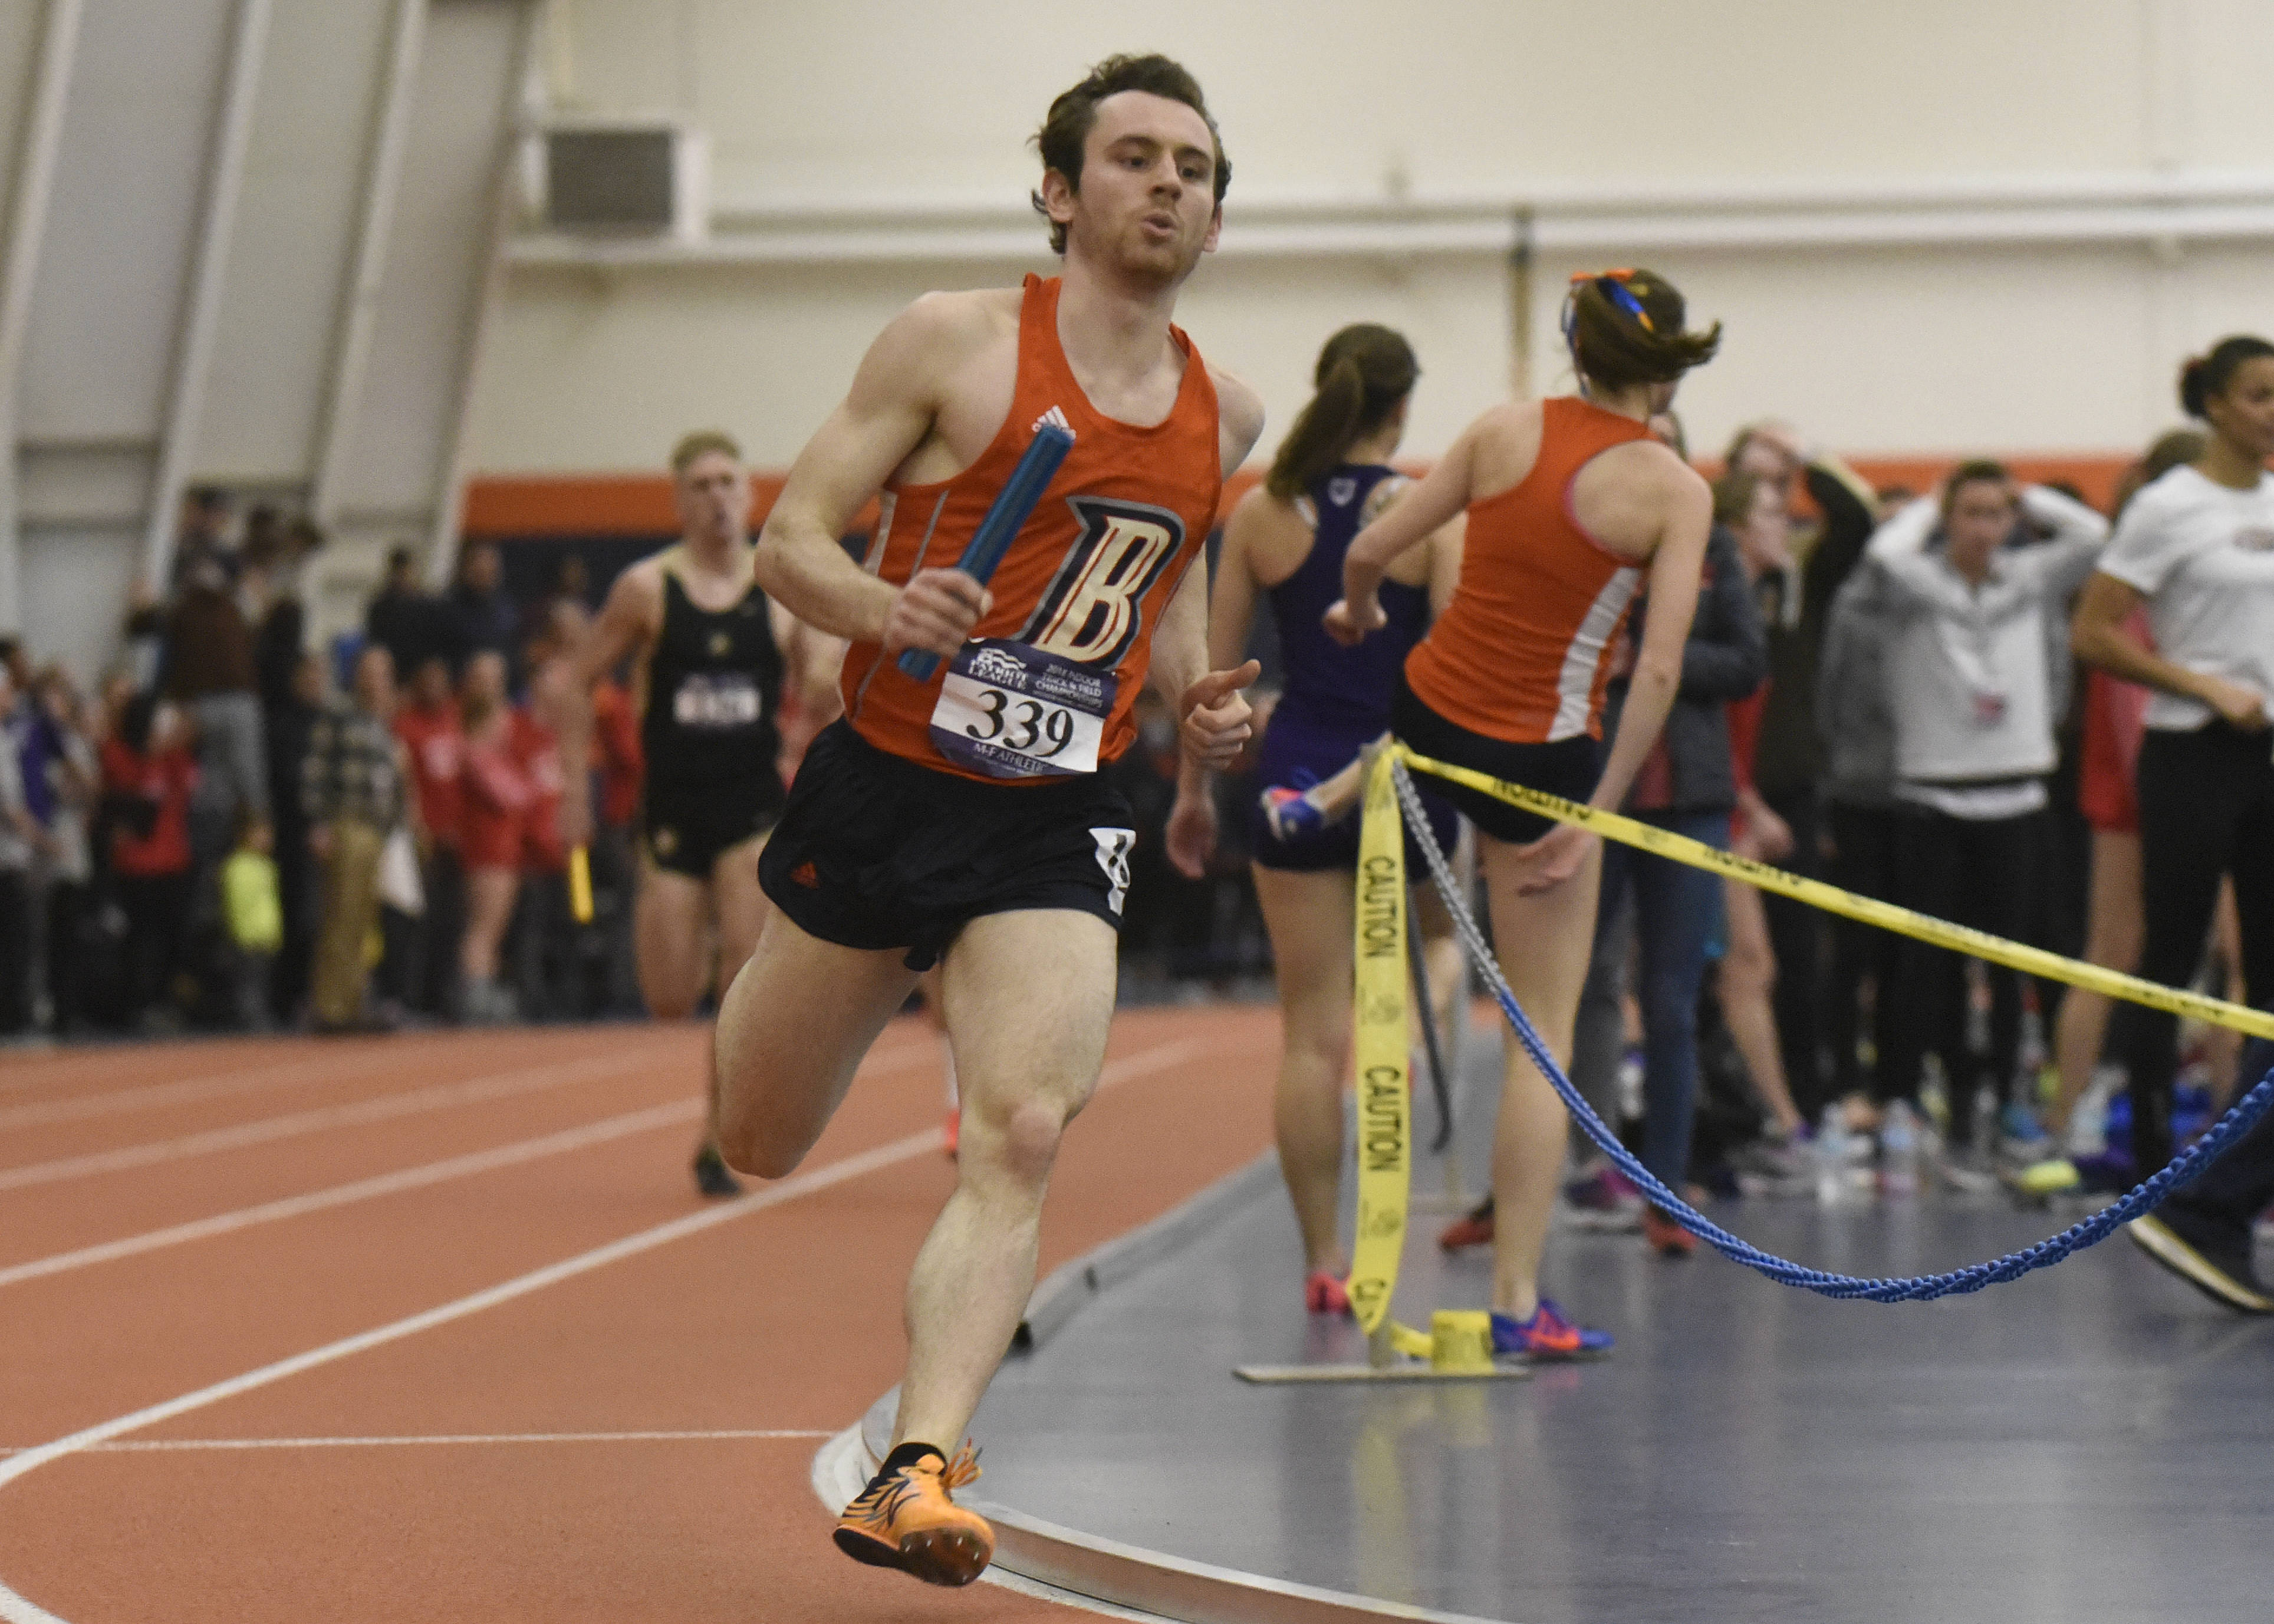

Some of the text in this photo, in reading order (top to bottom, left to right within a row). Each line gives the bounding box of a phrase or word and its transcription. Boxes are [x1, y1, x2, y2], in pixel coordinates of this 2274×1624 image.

[1015, 501, 1181, 668] B
[966, 689, 1074, 757] 339
[1363, 855, 1397, 958] CAUTION
[1364, 1065, 1403, 1173] CAUTION
